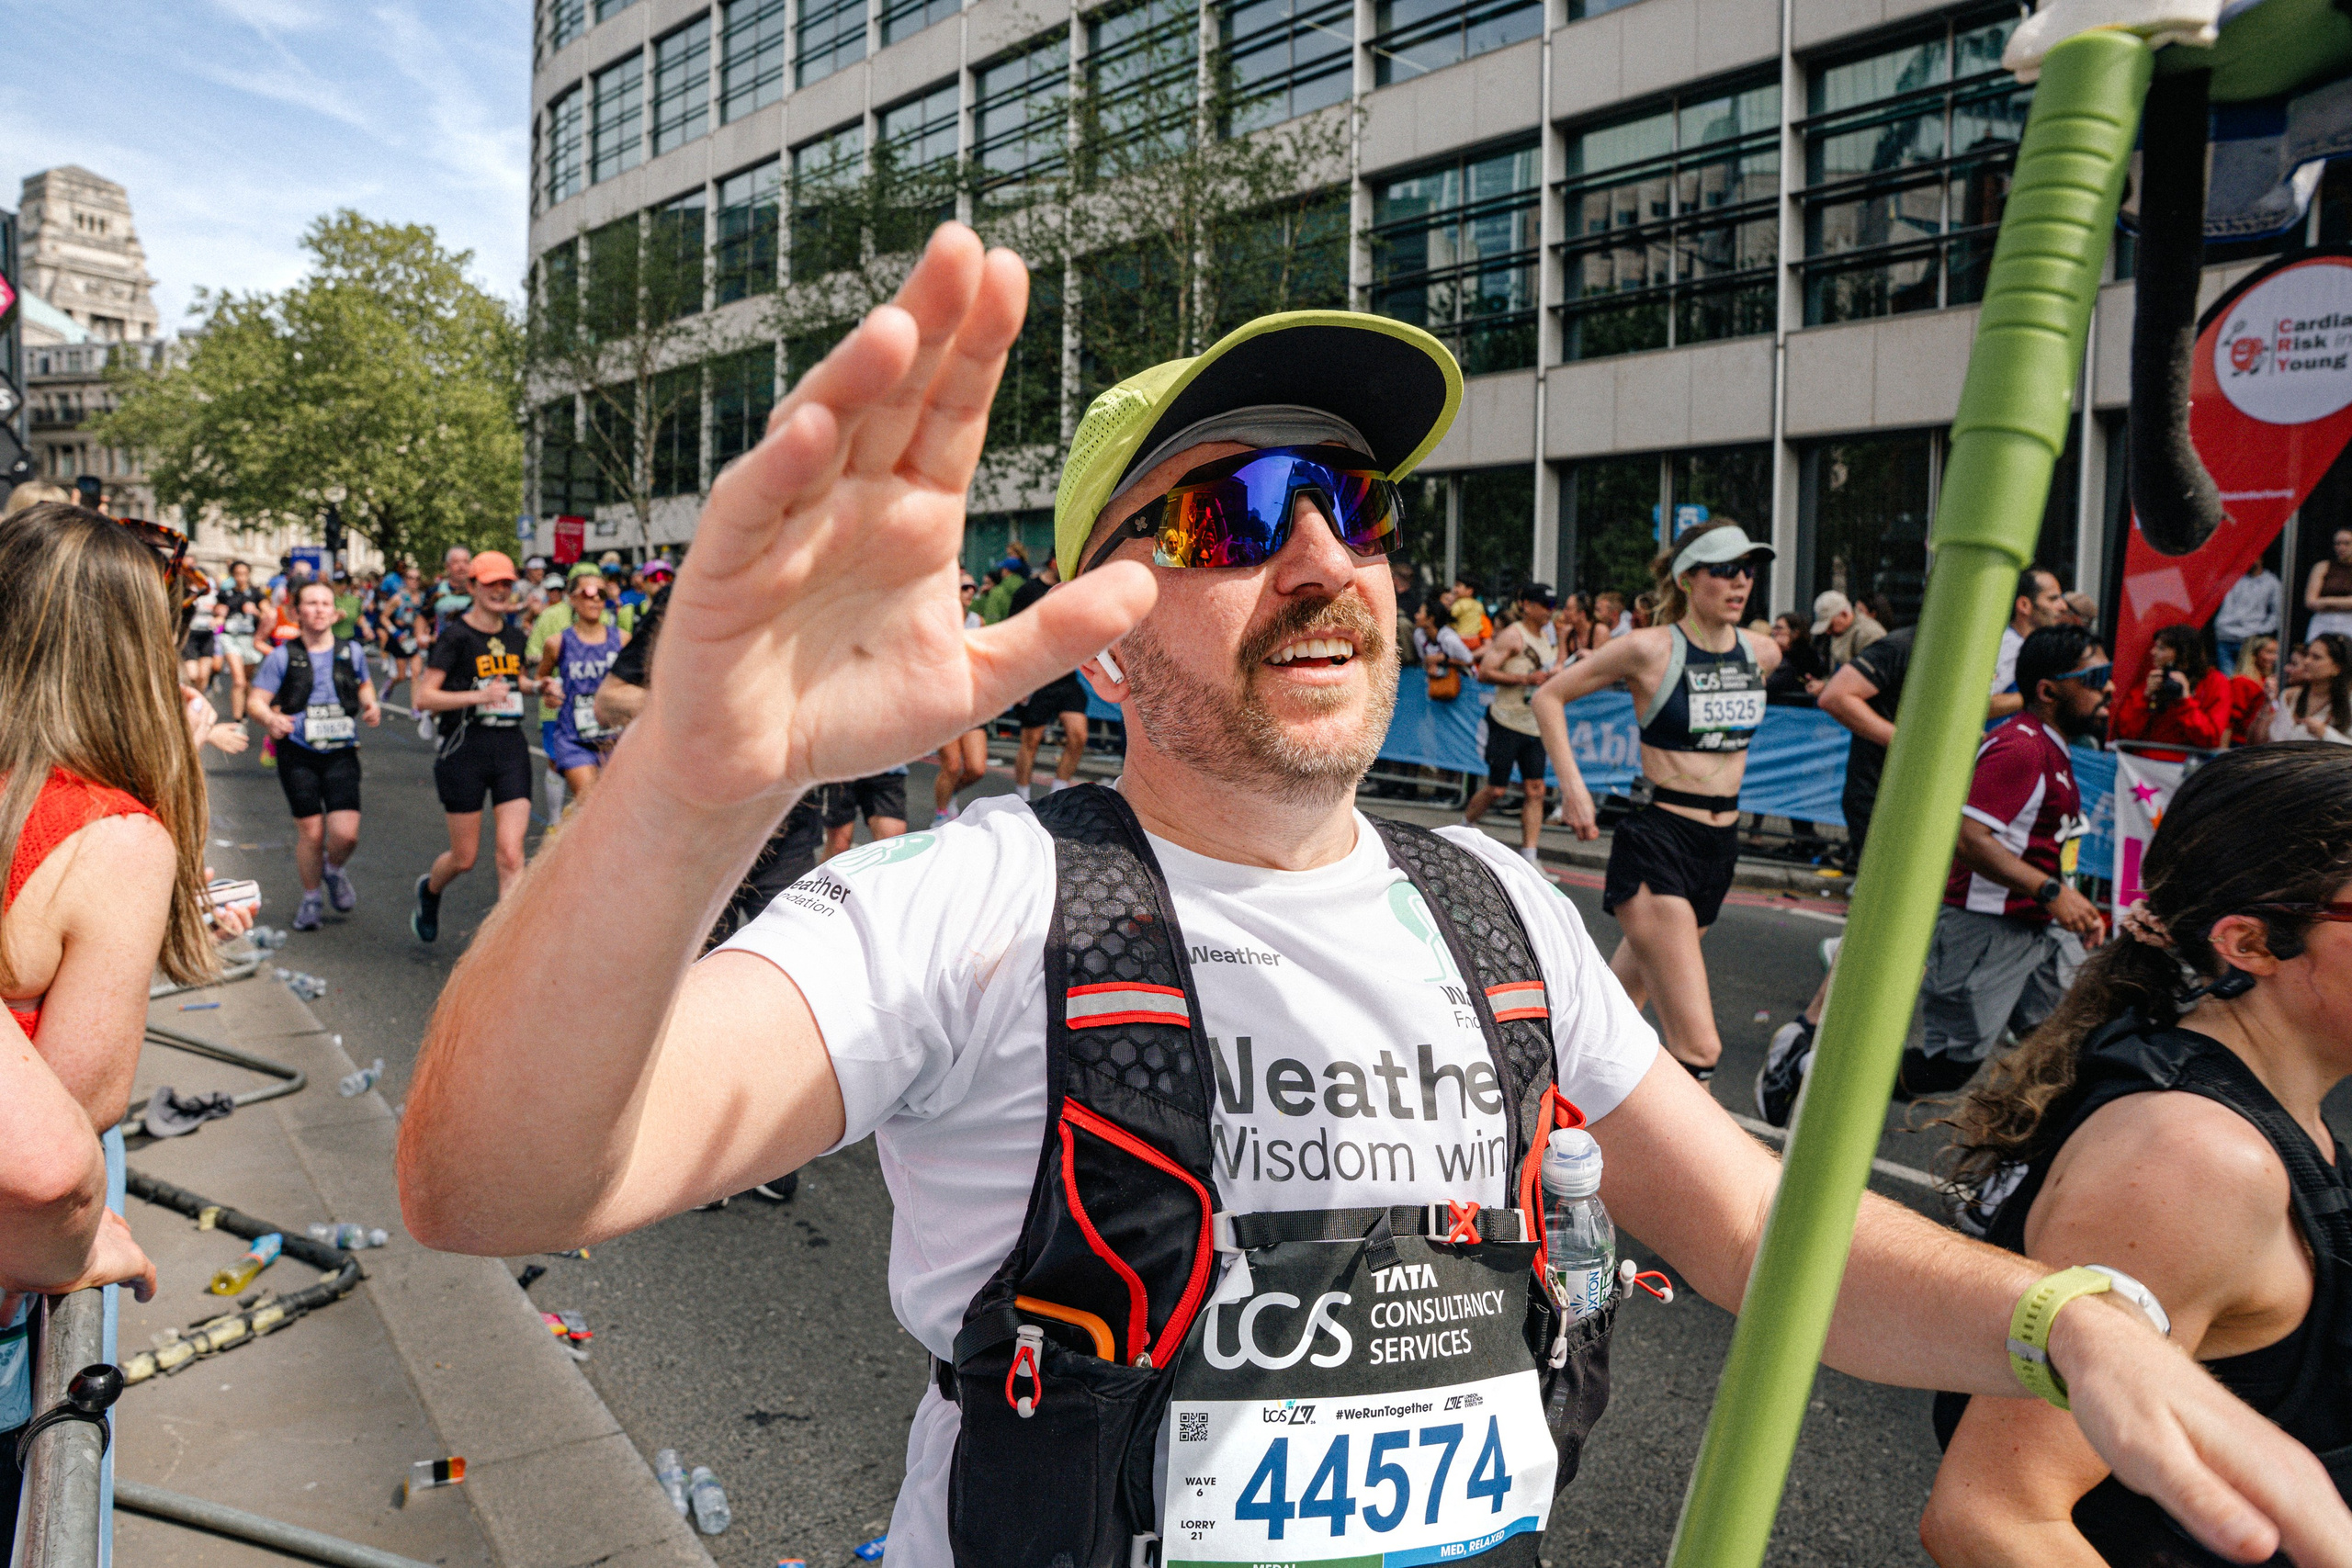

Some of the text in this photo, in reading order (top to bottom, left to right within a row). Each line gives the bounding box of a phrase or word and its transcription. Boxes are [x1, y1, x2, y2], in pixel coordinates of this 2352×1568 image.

[2277, 335, 2326, 352] Risk
[2277, 352, 2347, 373] Young
[1704, 699, 1757, 722] 53525
[1371, 1263, 1439, 1293] TATA
[1370, 1289, 1505, 1329] CONSULTANCY
[1370, 1328, 1472, 1365] SERVICES
[1336, 1402, 1433, 1420] #WeRunTogether
[1185, 1477, 1216, 1486] WAVE
[1235, 1415, 1512, 1540] 44574
[1196, 1488, 1204, 1497] 6
[1181, 1520, 1216, 1529] LORRY
[1191, 1531, 1203, 1540] 21
[1441, 1529, 1505, 1557] MED, RELAXED
